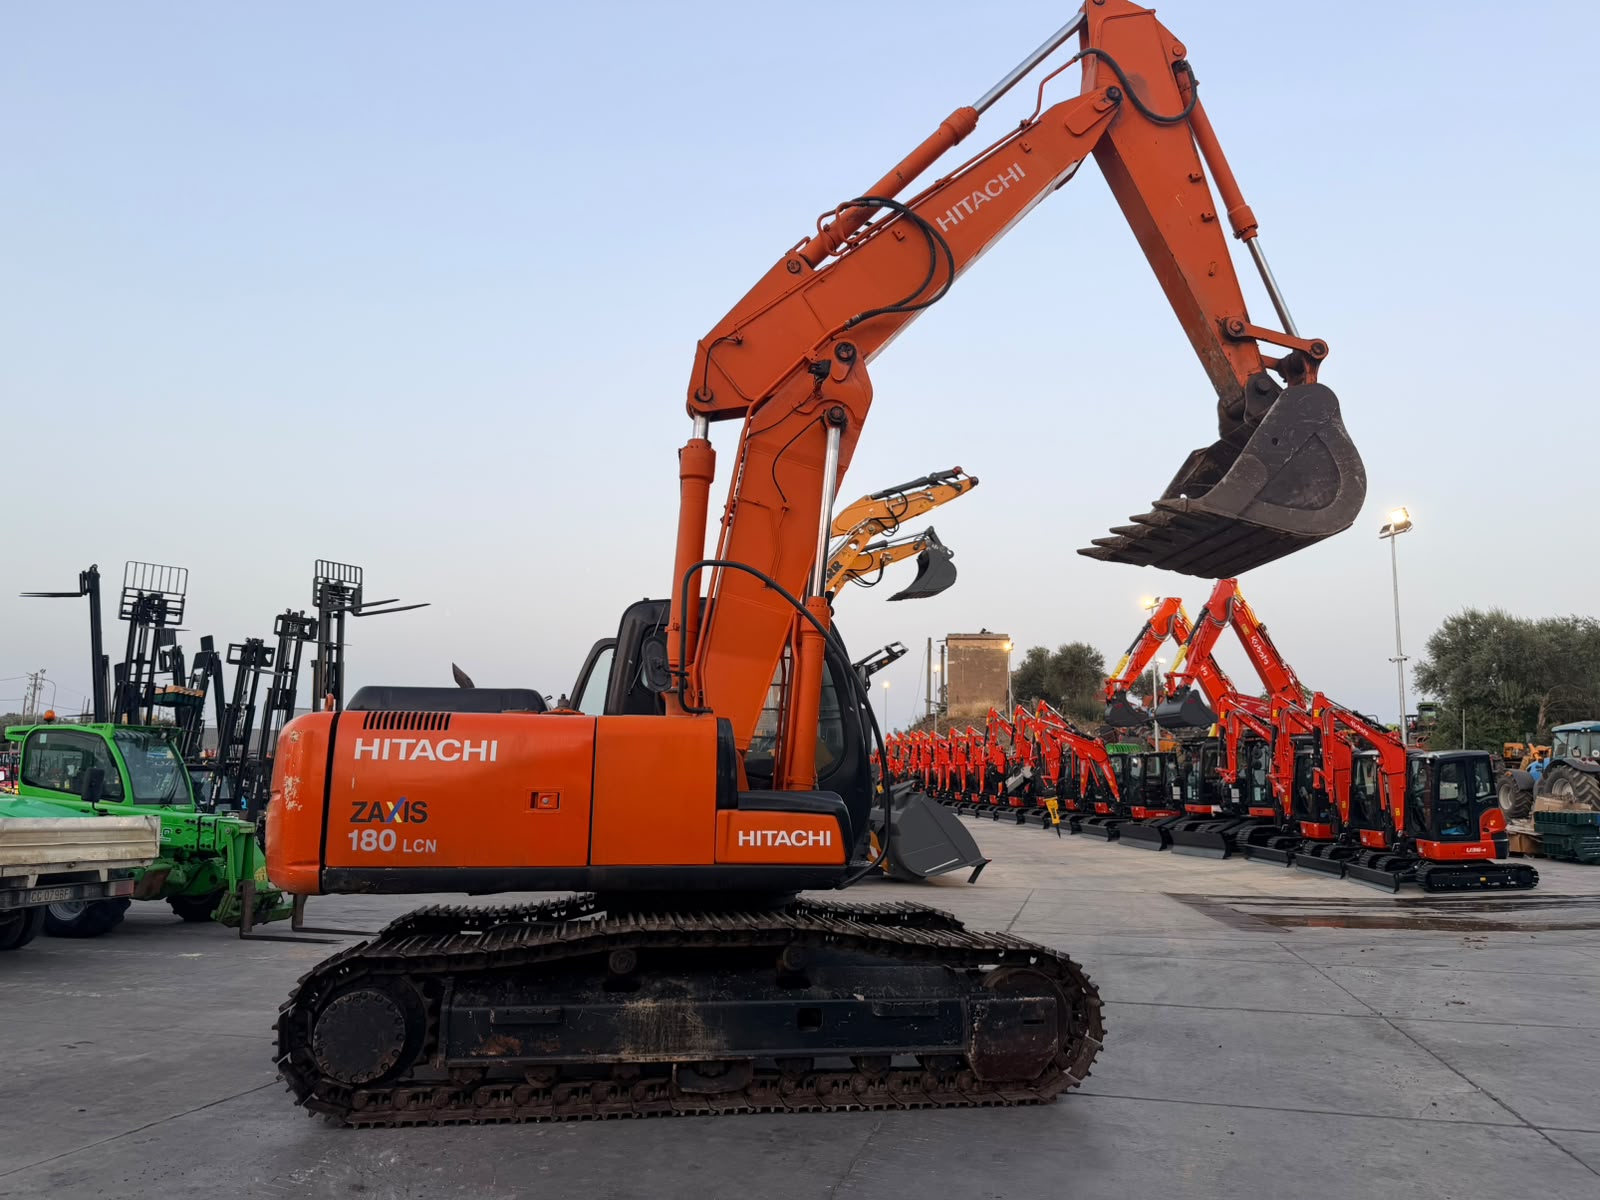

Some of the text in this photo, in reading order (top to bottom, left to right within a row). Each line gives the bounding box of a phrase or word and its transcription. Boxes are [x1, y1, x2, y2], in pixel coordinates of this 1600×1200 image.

[935, 162, 1026, 233] HITACHI
[1251, 635, 1269, 665] Kubota
[354, 737, 498, 762] HITACHI
[350, 796, 428, 824] ZAXIS
[348, 829, 437, 853] 180 LCN
[738, 829, 831, 847] HITACHI
